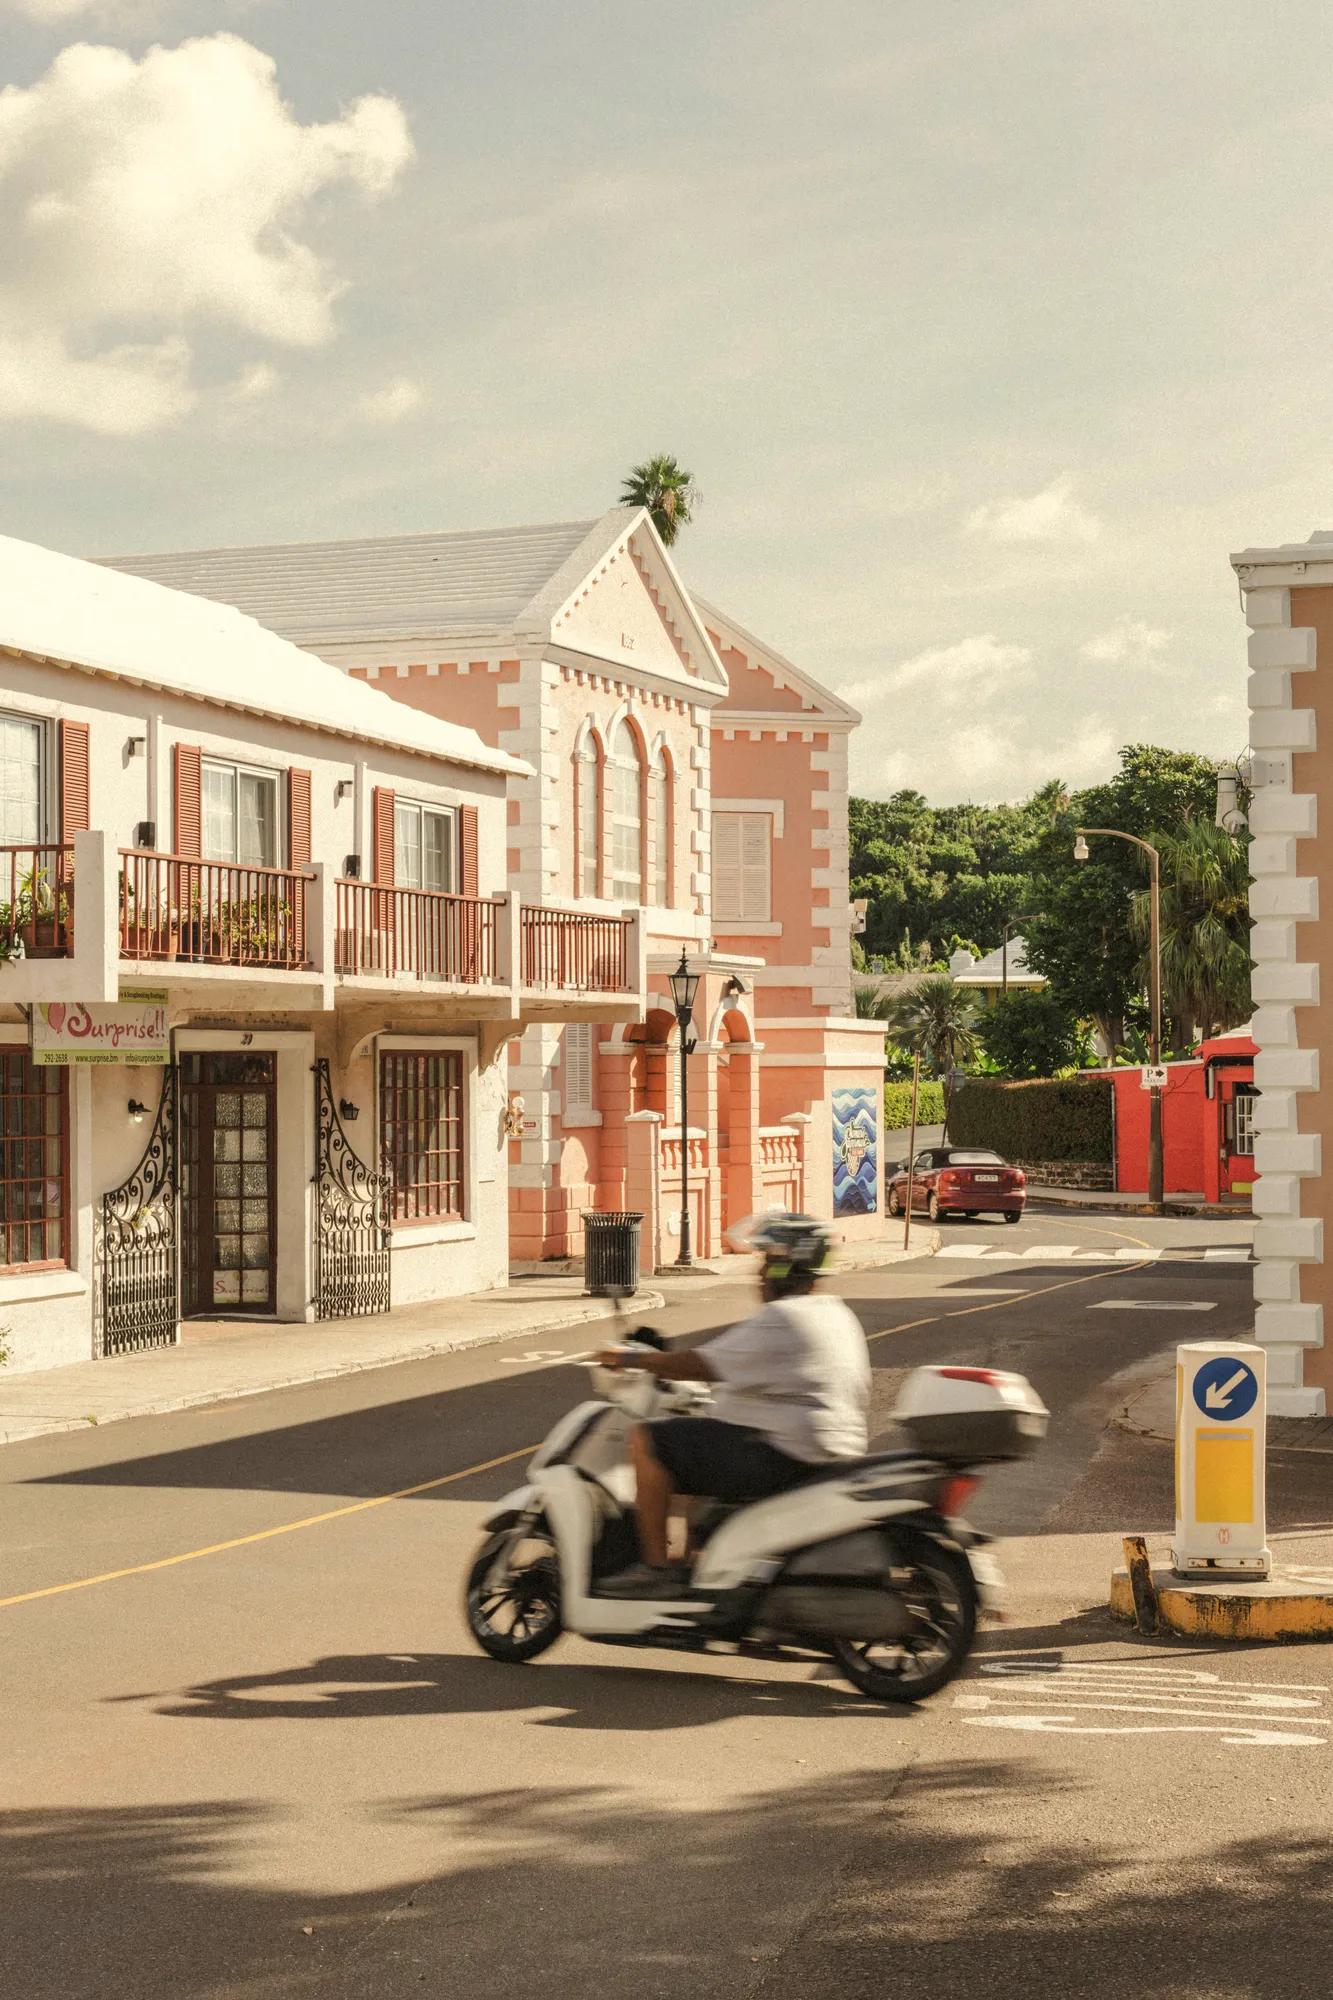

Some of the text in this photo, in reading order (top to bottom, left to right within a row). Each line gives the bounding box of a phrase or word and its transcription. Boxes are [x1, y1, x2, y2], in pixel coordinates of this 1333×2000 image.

[67, 1003, 165, 1047] Surprise!!
[75, 1053, 119, 1063] www.surprise.bm
[125, 1053, 164, 1063] info@surprise.bm
[1146, 1069, 1154, 1078] P
